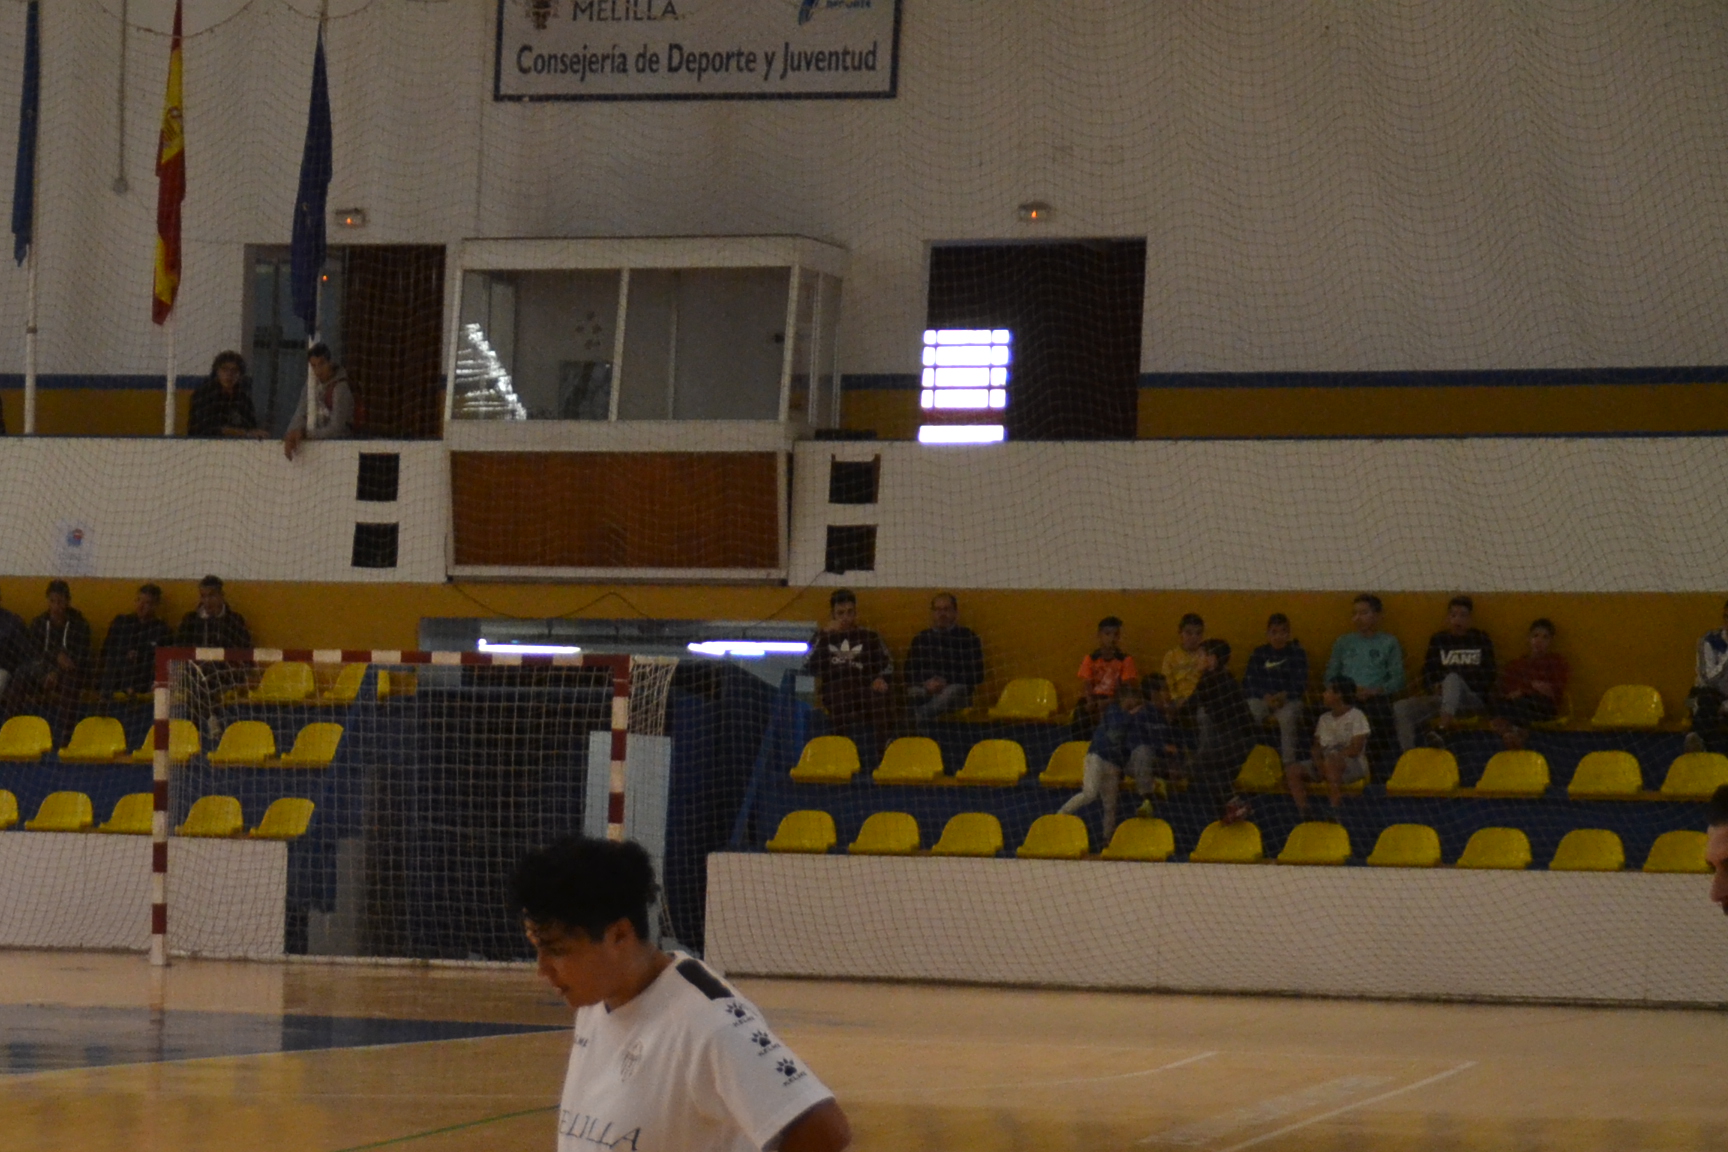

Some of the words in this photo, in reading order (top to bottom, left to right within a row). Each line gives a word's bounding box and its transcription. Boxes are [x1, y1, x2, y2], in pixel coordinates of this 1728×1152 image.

[515, 43, 628, 83] Consejería
[634, 44, 660, 73] de
[667, 43, 757, 81] Deporte
[763, 50, 775, 81] y
[781, 41, 878, 80] Juventud
[1440, 648, 1482, 666] VANS
